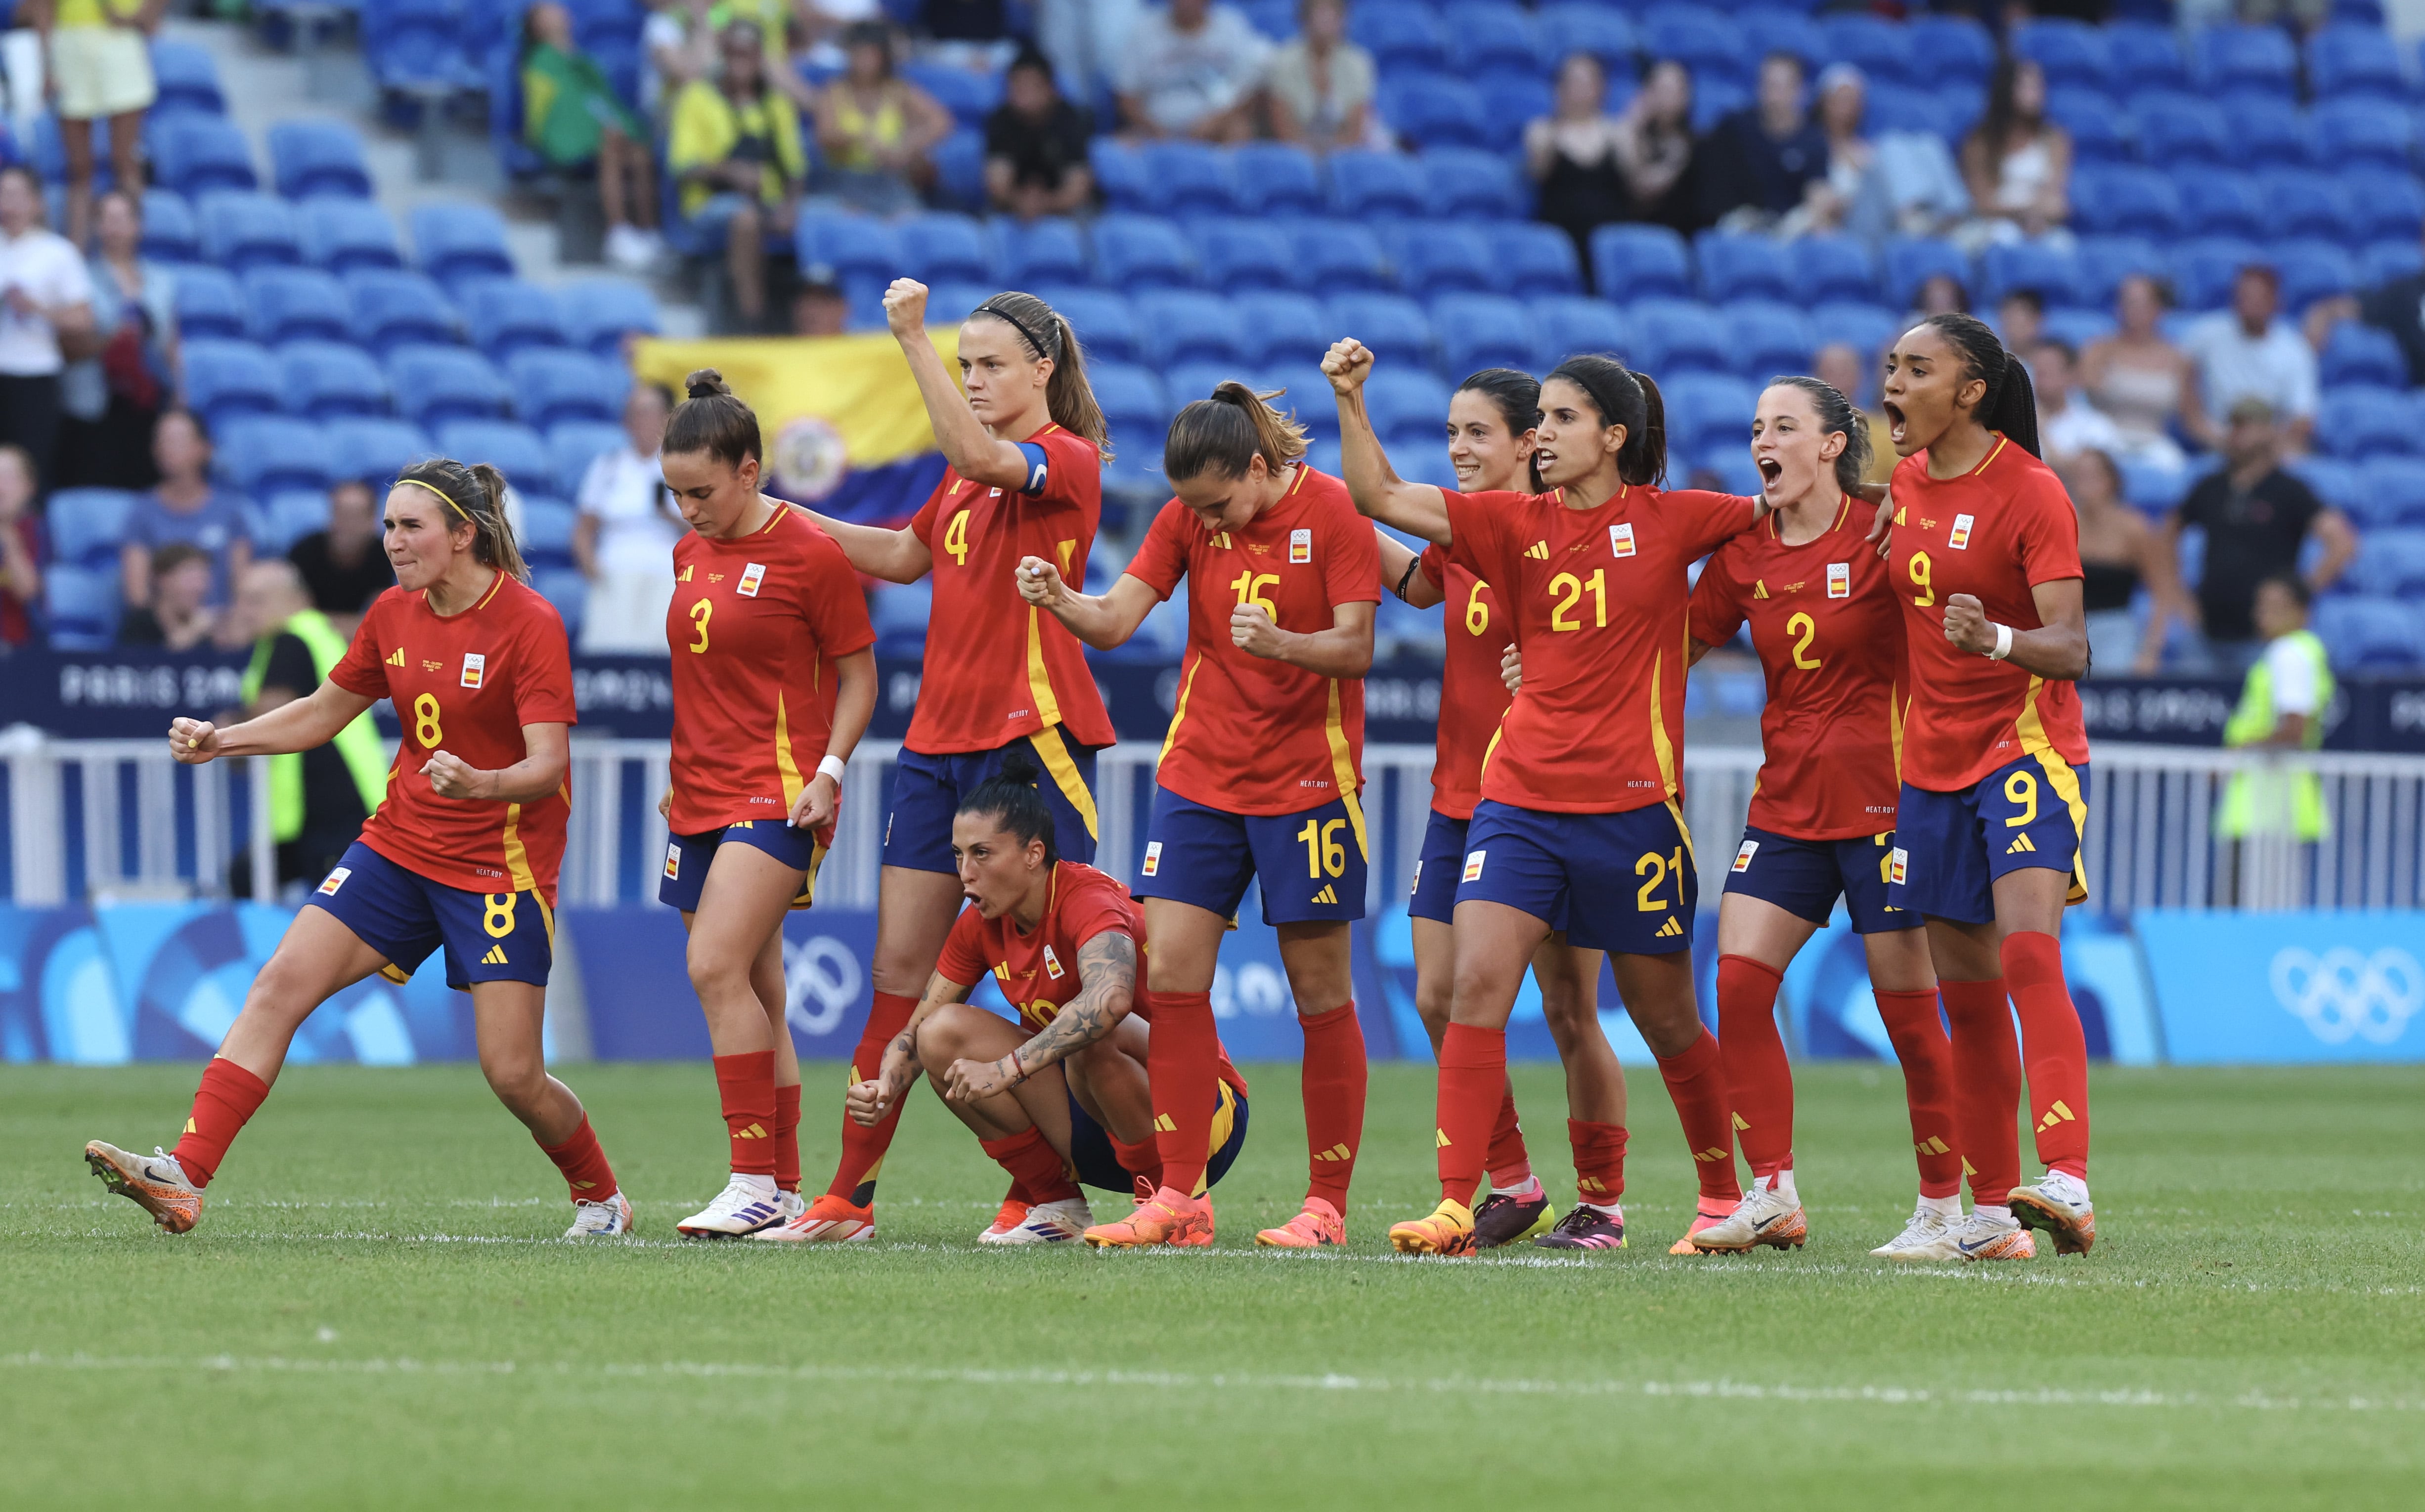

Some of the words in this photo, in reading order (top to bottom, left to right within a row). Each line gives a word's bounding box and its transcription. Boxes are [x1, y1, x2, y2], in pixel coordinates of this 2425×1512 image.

[944, 510, 970, 565] 4
[1230, 570, 1279, 625] 16
[1548, 568, 1606, 632] 21
[1909, 551, 1935, 606] 9
[690, 598, 712, 654] 3
[1466, 580, 1490, 636] 6
[1787, 612, 1821, 669] 2
[60, 665, 178, 708] PARIS
[1008, 709, 1028, 719] HEAT.RDY
[414, 692, 443, 749] 8
[2004, 770, 2037, 827] 9
[476, 868, 503, 878] HEAT.RDY
[1298, 819, 1346, 878] 16
[1635, 846, 1684, 912] 21
[484, 893, 517, 939] 8
[1019, 999, 1059, 1029] 10
